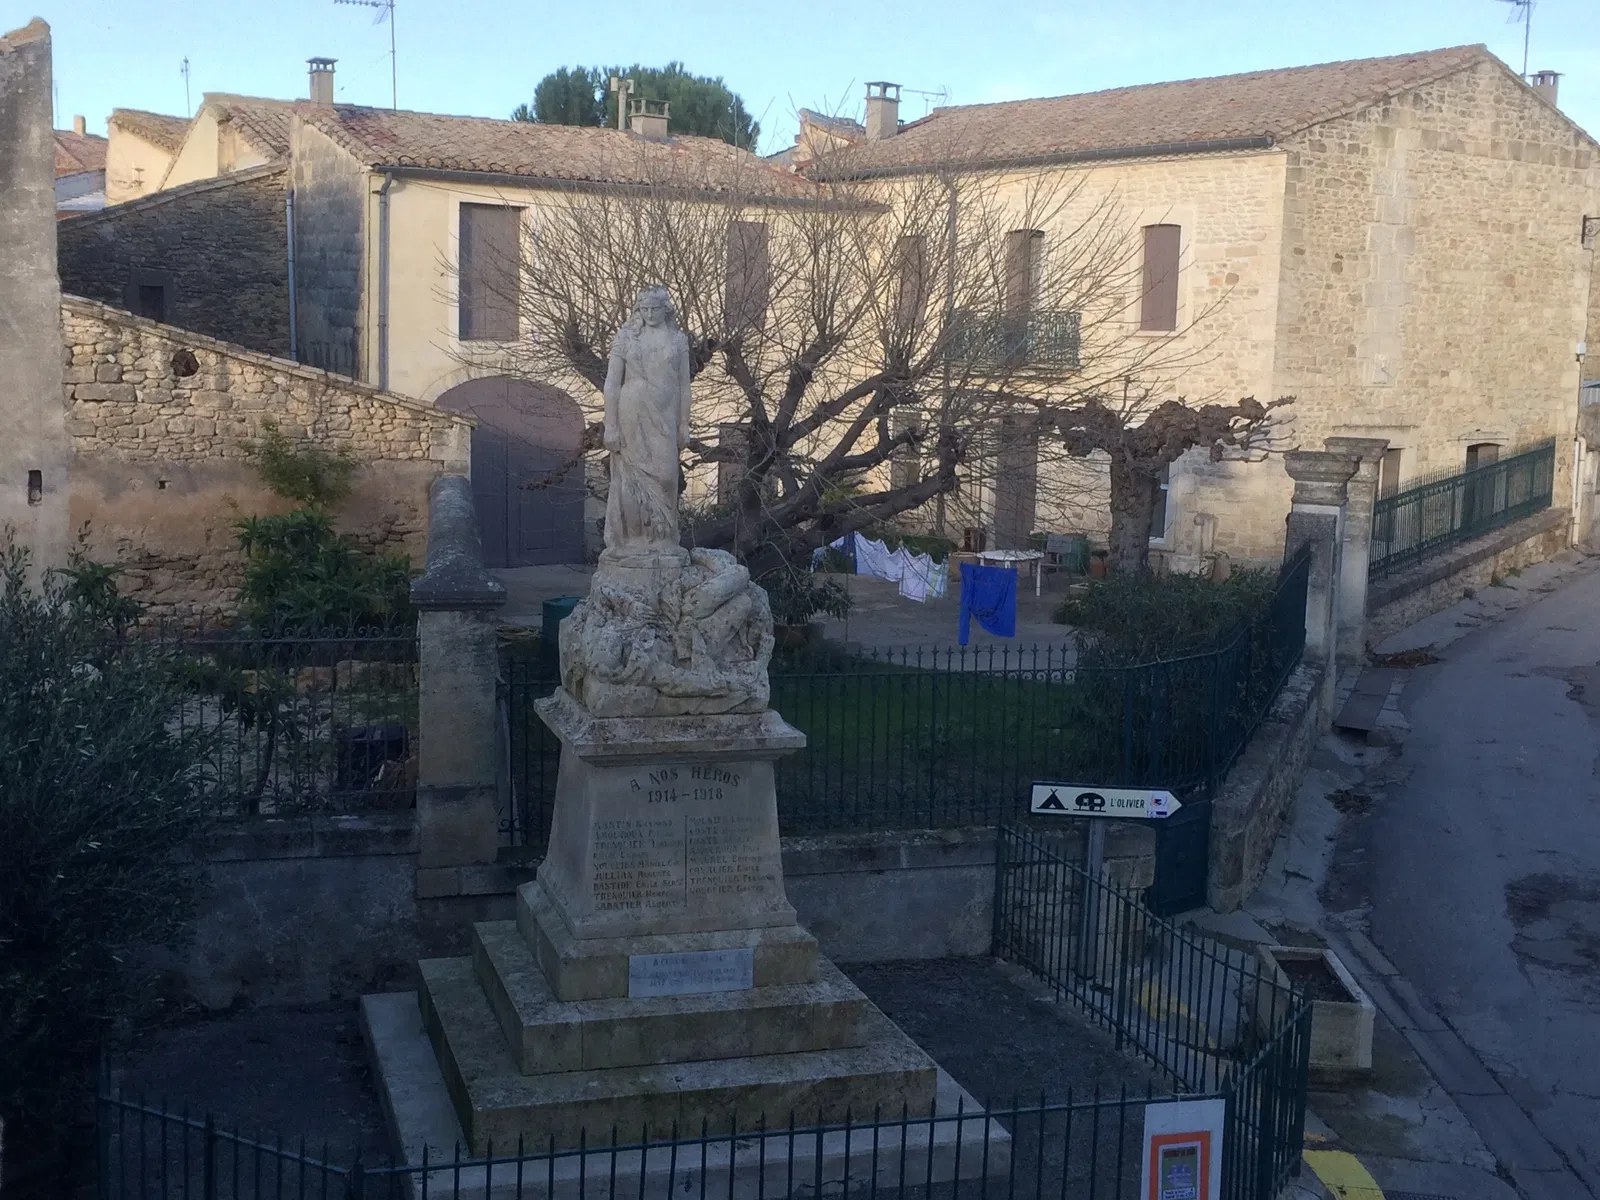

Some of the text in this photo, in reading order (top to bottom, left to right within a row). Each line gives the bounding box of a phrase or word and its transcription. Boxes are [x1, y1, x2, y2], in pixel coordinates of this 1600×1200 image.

[630, 779, 641, 792] A
[648, 768, 679, 785] NOS
[1110, 798, 1145, 808] L'OLIVIER
